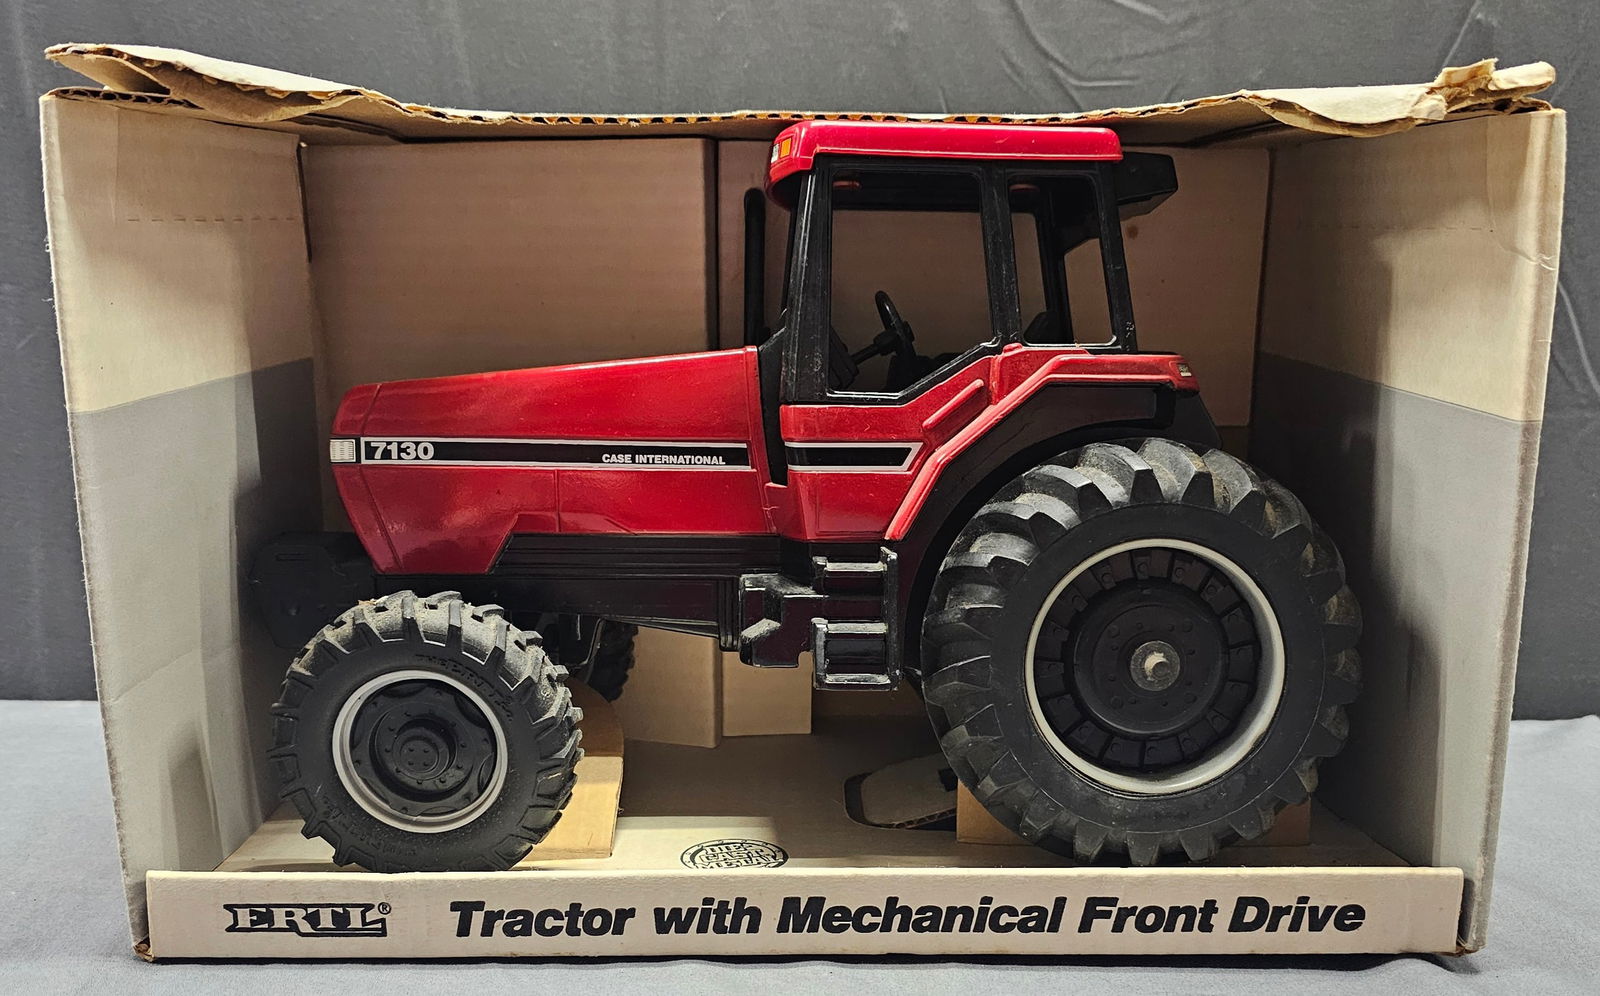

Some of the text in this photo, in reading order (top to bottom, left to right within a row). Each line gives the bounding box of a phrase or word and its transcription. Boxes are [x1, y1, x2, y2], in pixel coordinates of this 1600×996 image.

[370, 441, 435, 460] 7130
[601, 453, 726, 465] CASE INTERNATIONAL
[450, 895, 1366, 938] Tractor with Mechanical Front Drive
